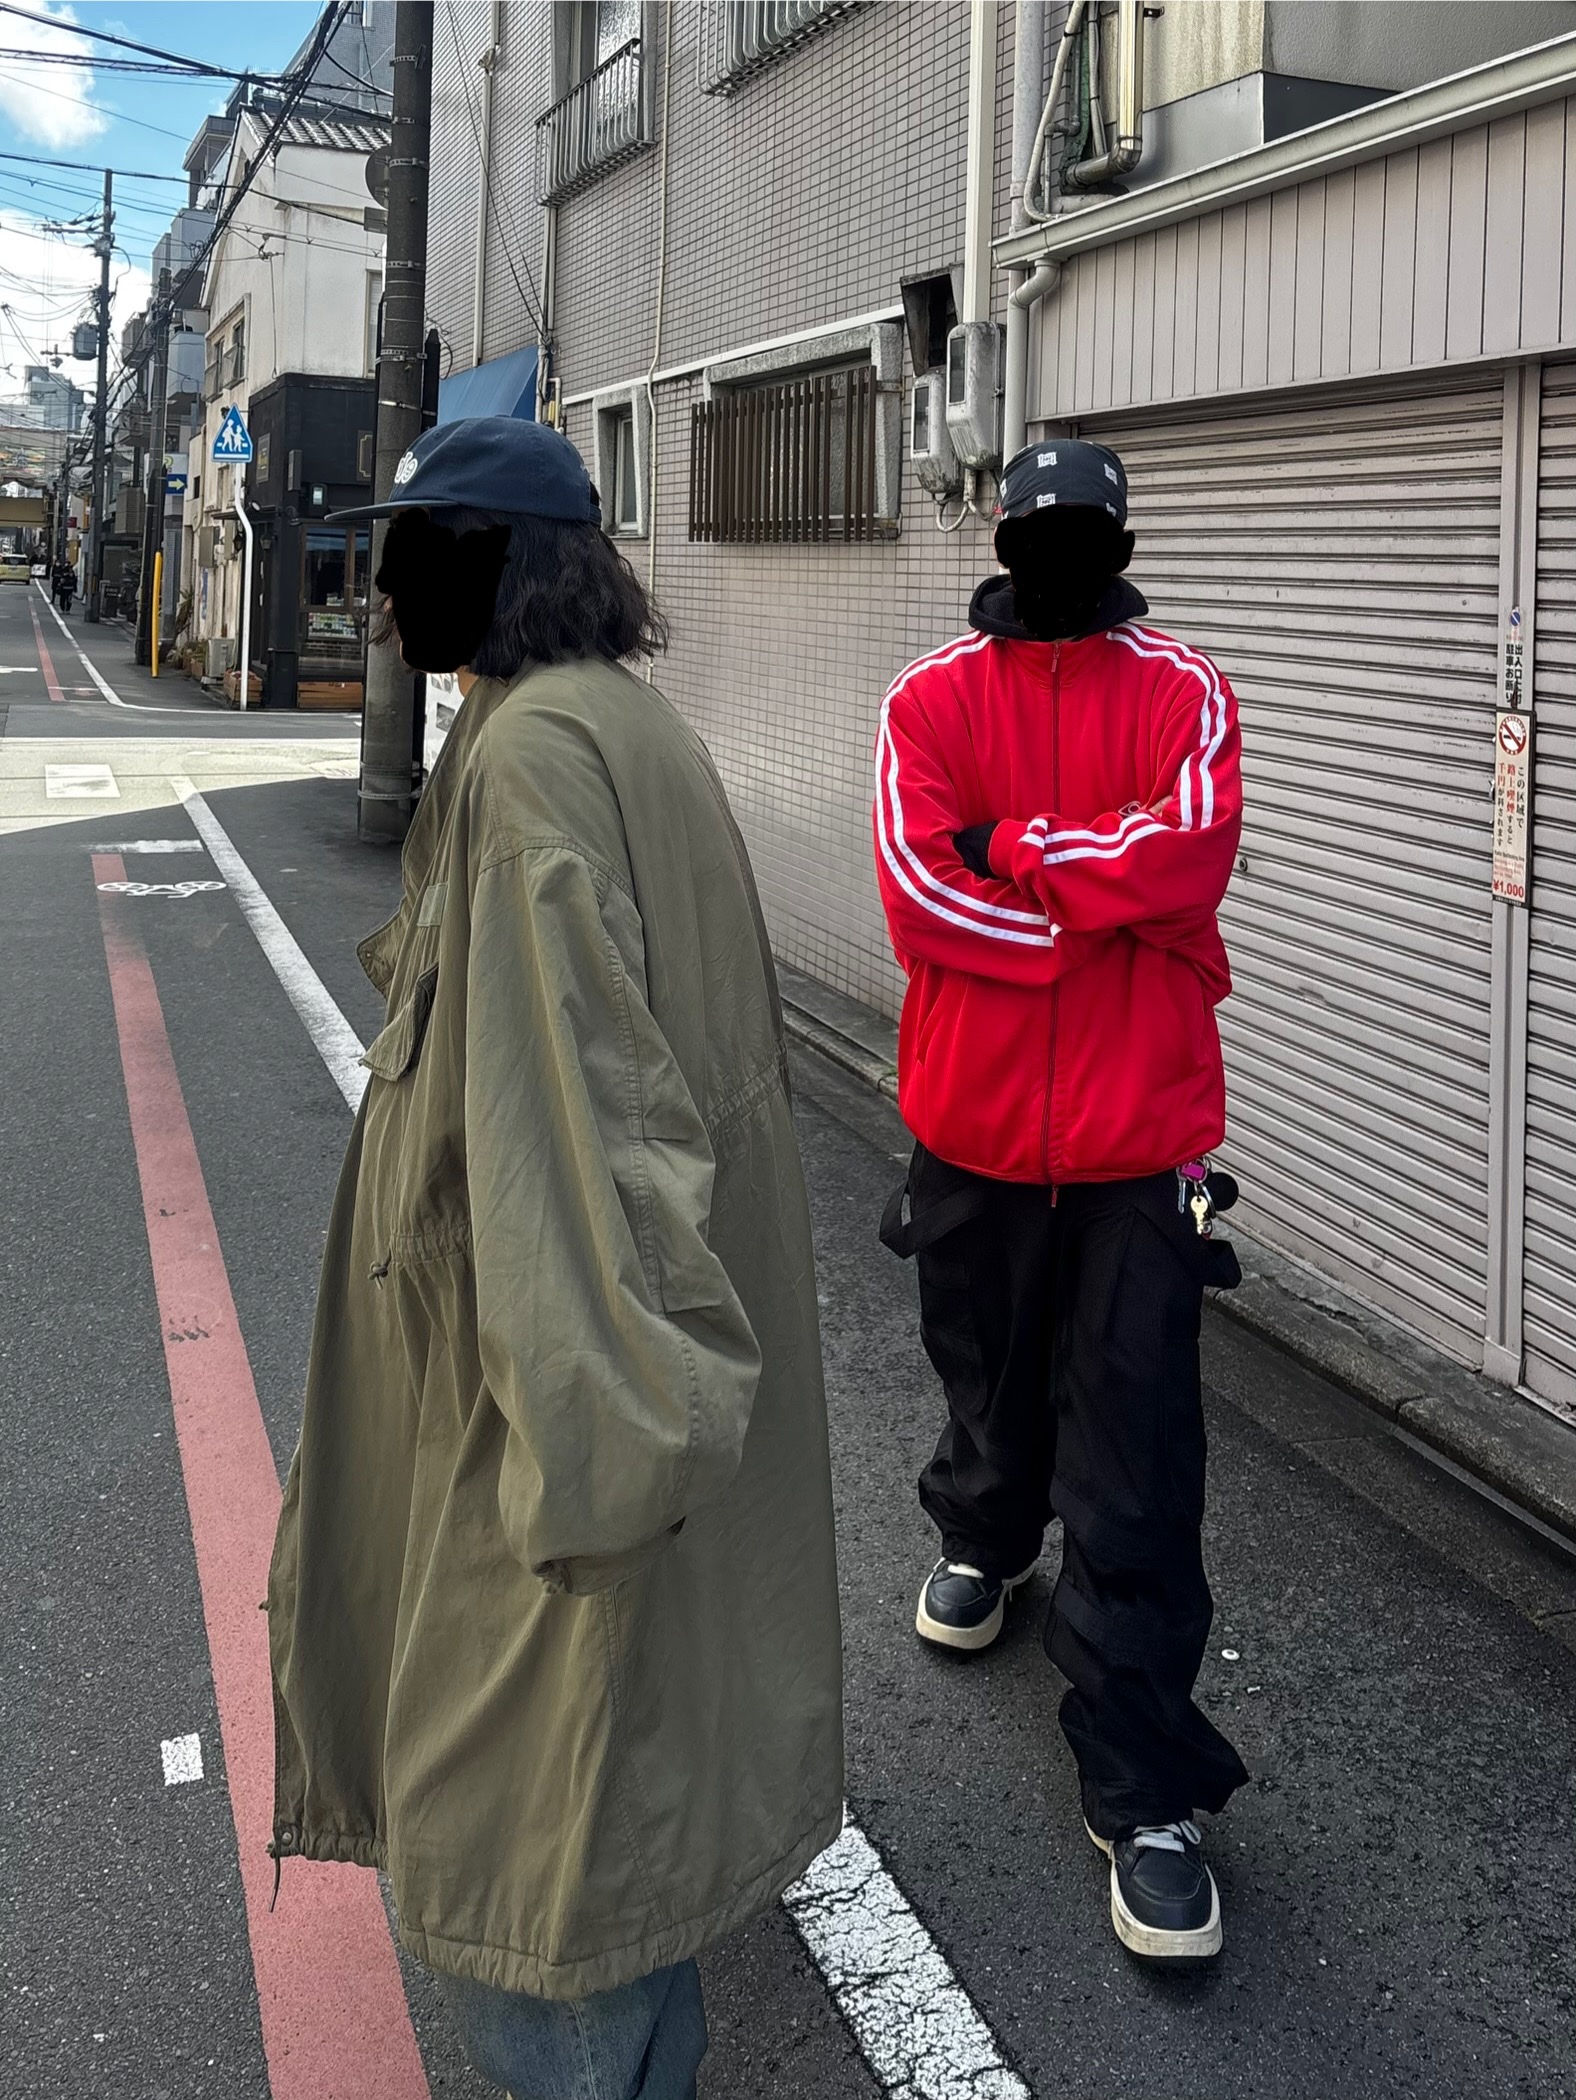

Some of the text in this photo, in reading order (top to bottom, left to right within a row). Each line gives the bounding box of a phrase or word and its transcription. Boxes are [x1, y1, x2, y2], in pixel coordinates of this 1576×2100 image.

[1497, 762, 1506, 847] 千円が科されます
[1506, 763, 1516, 845] 路上喫煙すると
[1516, 766, 1526, 829] この区域で
[1493, 879, 1525, 898] ¥1,000
